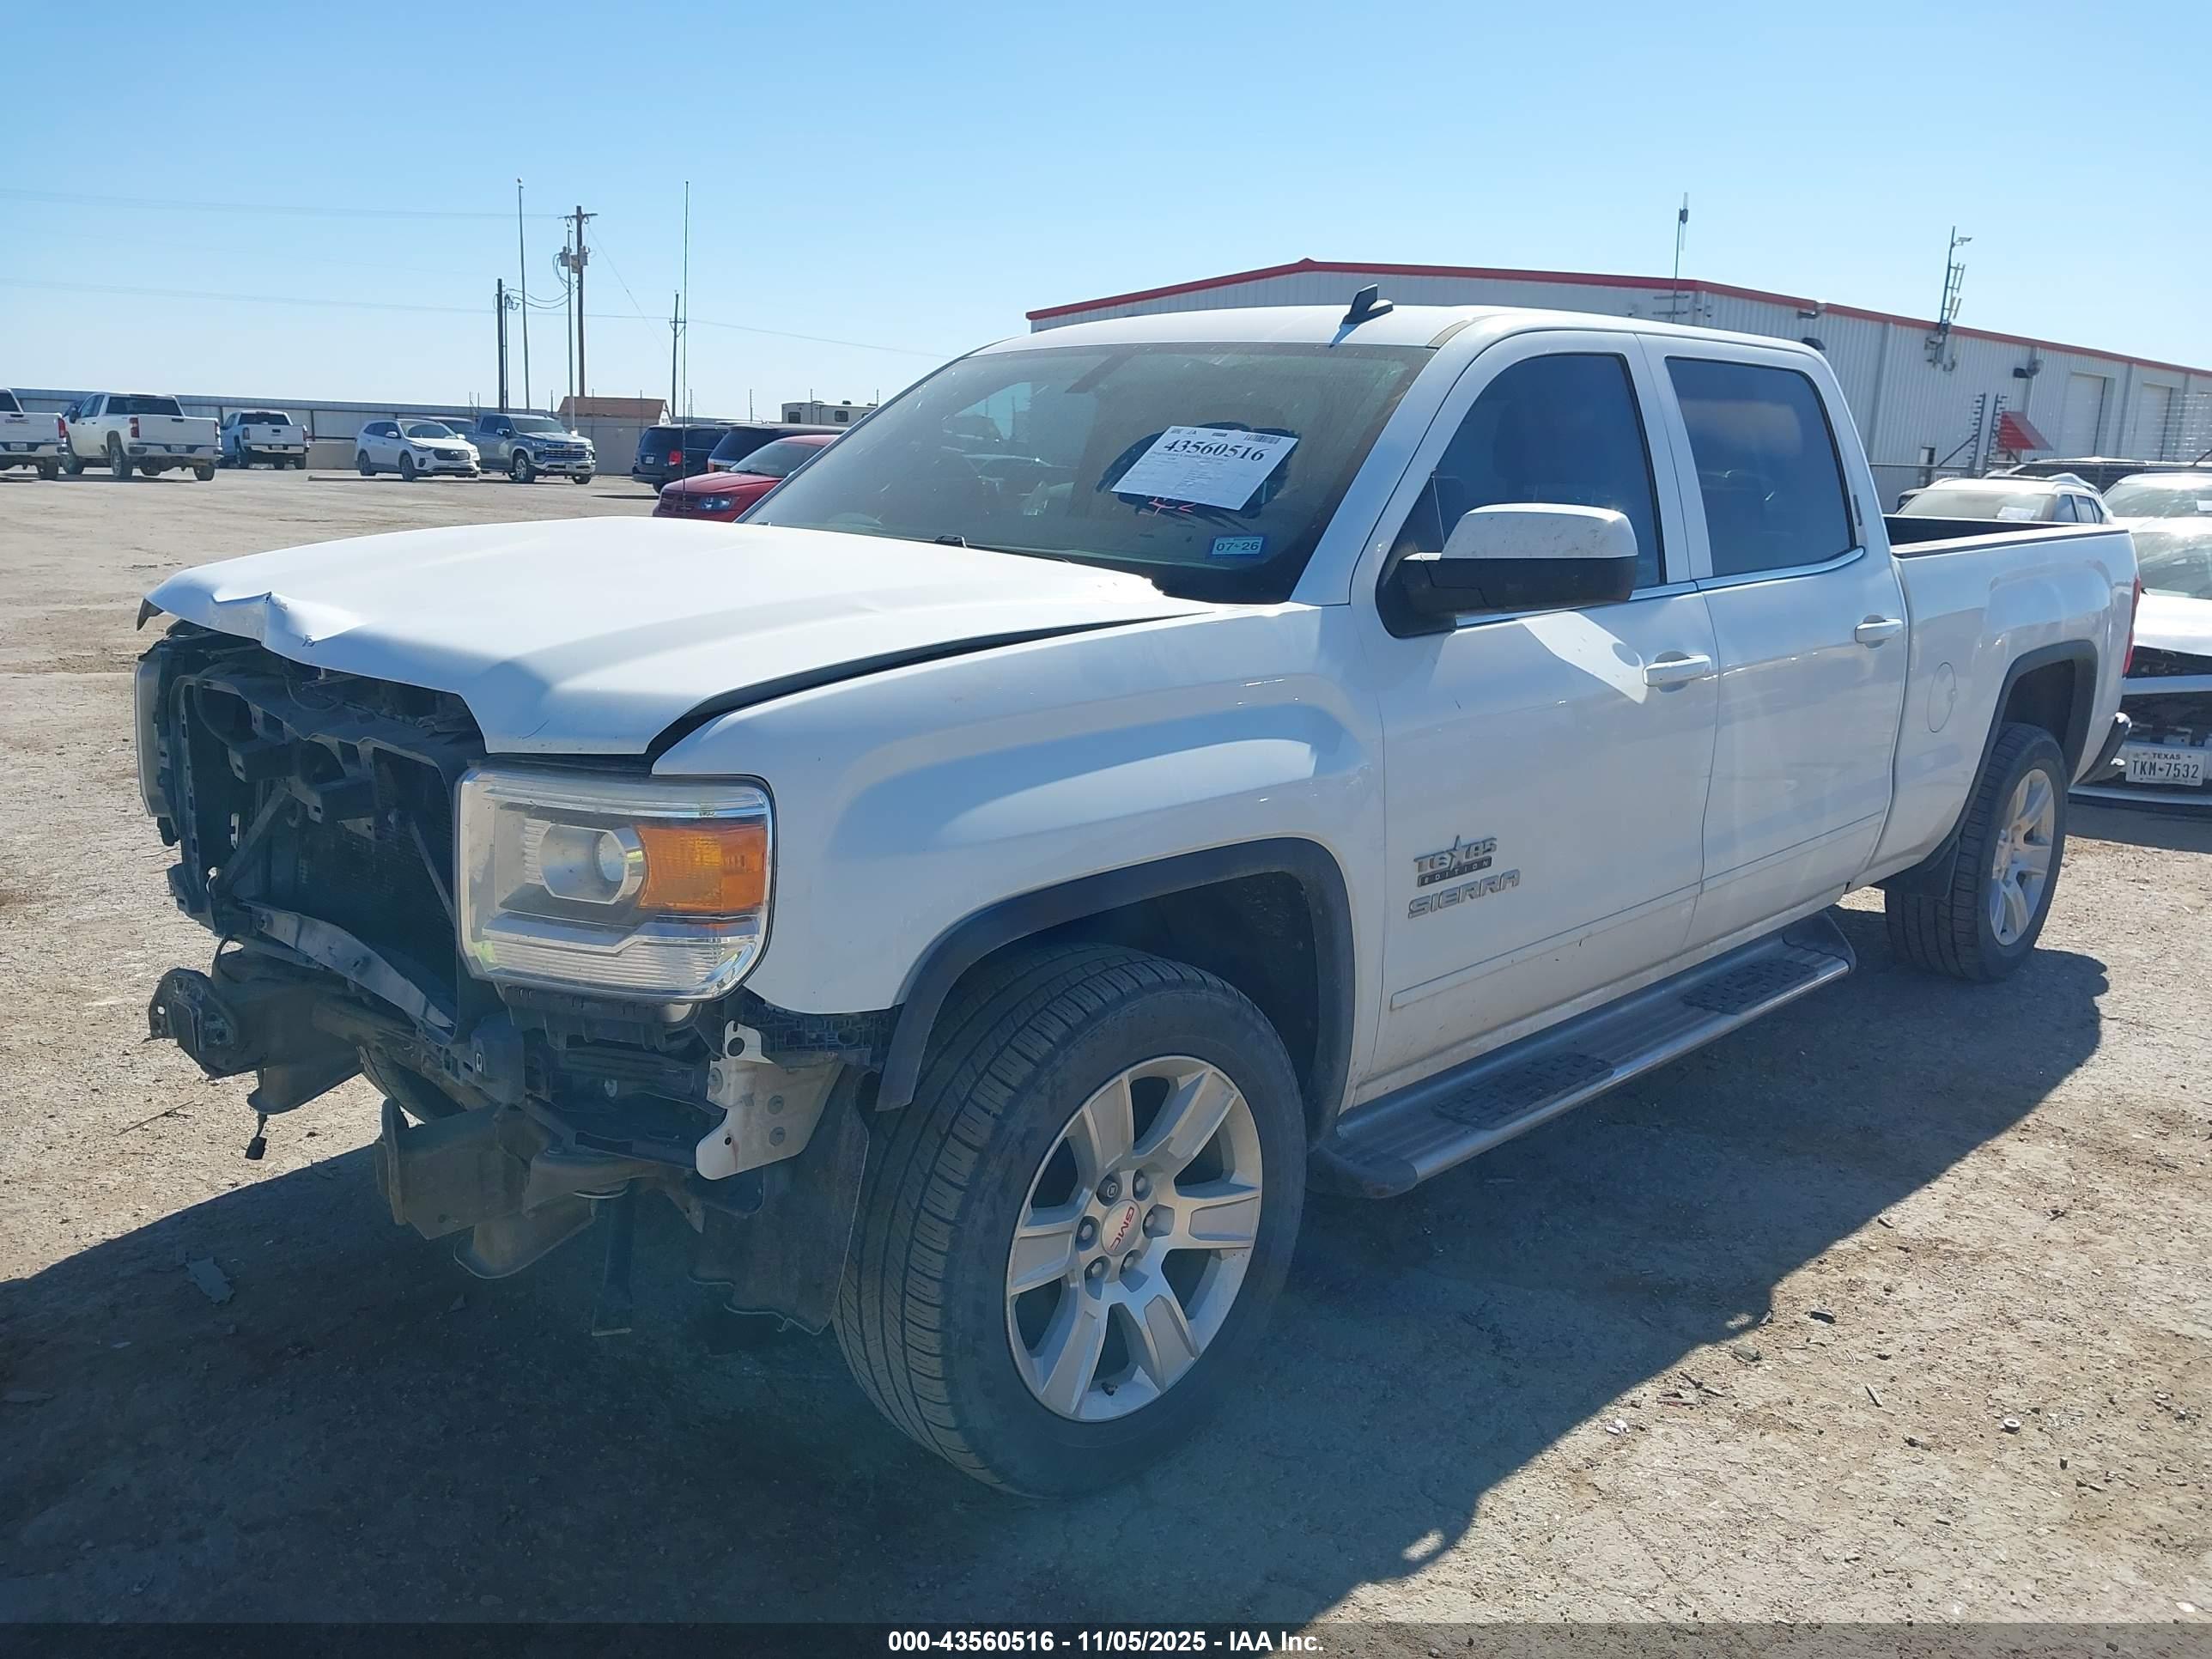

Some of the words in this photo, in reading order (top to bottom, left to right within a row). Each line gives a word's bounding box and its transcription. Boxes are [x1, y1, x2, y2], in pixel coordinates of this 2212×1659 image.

[1164, 439, 1271, 462] 43560516
[1413, 835, 1498, 872] TEXAS
[1419, 860, 1490, 884] EDITION
[1408, 869, 1521, 919] SIERRA
[1109, 1206, 1135, 1251] GMC
